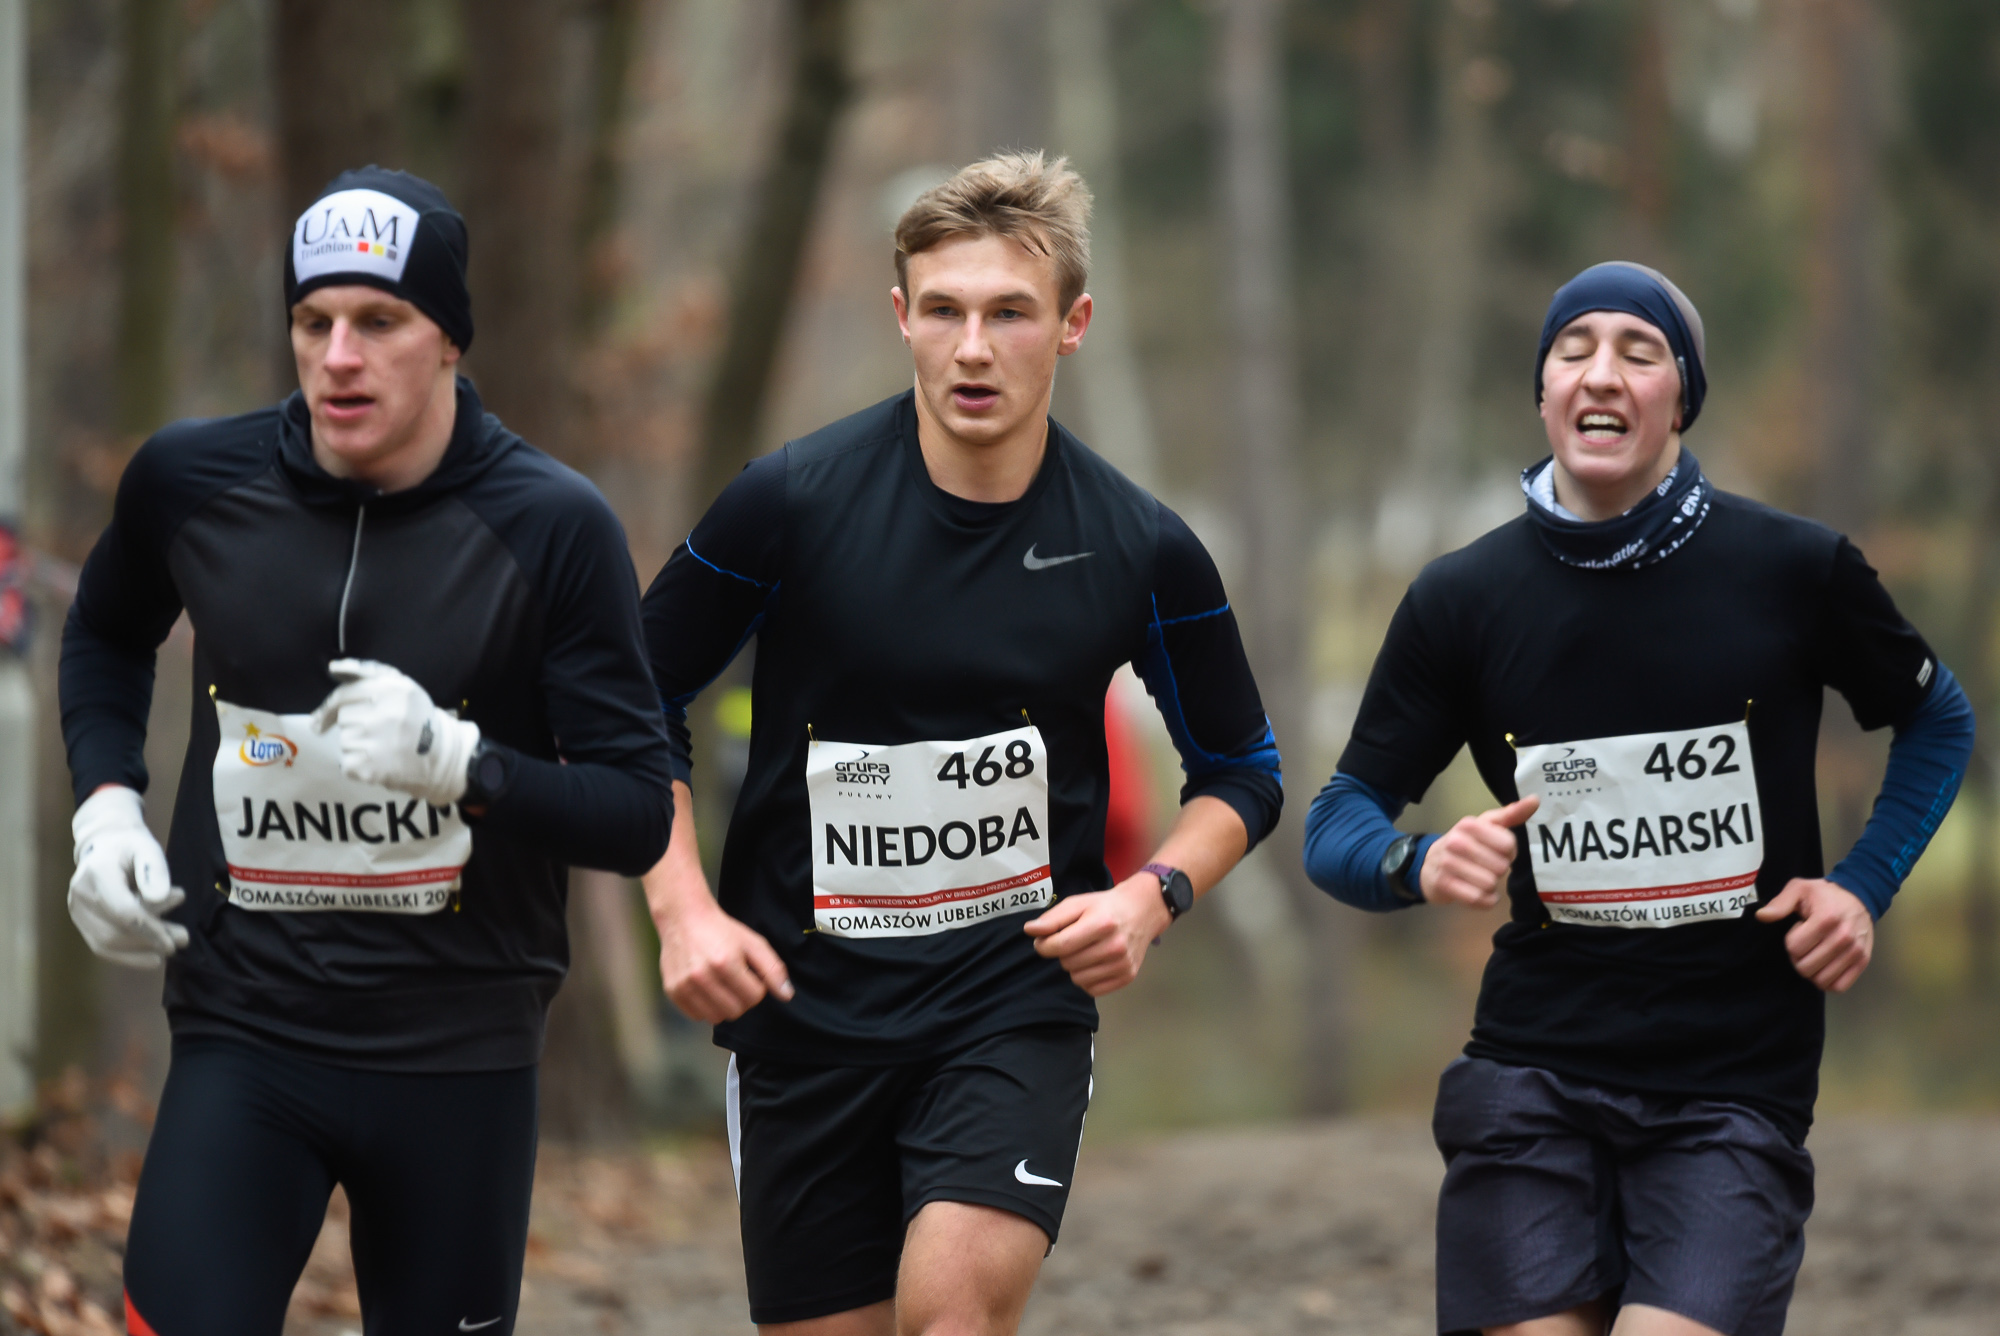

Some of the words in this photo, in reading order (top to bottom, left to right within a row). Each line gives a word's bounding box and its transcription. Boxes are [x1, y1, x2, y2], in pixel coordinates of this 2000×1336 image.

[302, 207, 401, 247] UAM
[251, 739, 284, 760] LOTTO
[936, 739, 1035, 790] 468
[1643, 734, 1740, 783] 462
[825, 806, 1041, 867] NIEDOBA
[1537, 802, 1755, 864] MASARSKI
[234, 886, 335, 906] TOMASZÓW
[342, 892, 419, 908] LUBELSKI
[829, 911, 931, 930] TOMASZÓW
[937, 897, 1005, 924] LUBELSKI
[1010, 887, 1046, 907] 2021
[1557, 905, 1647, 922] TOMASZÓW
[1654, 899, 1723, 920] LUBELSKI
